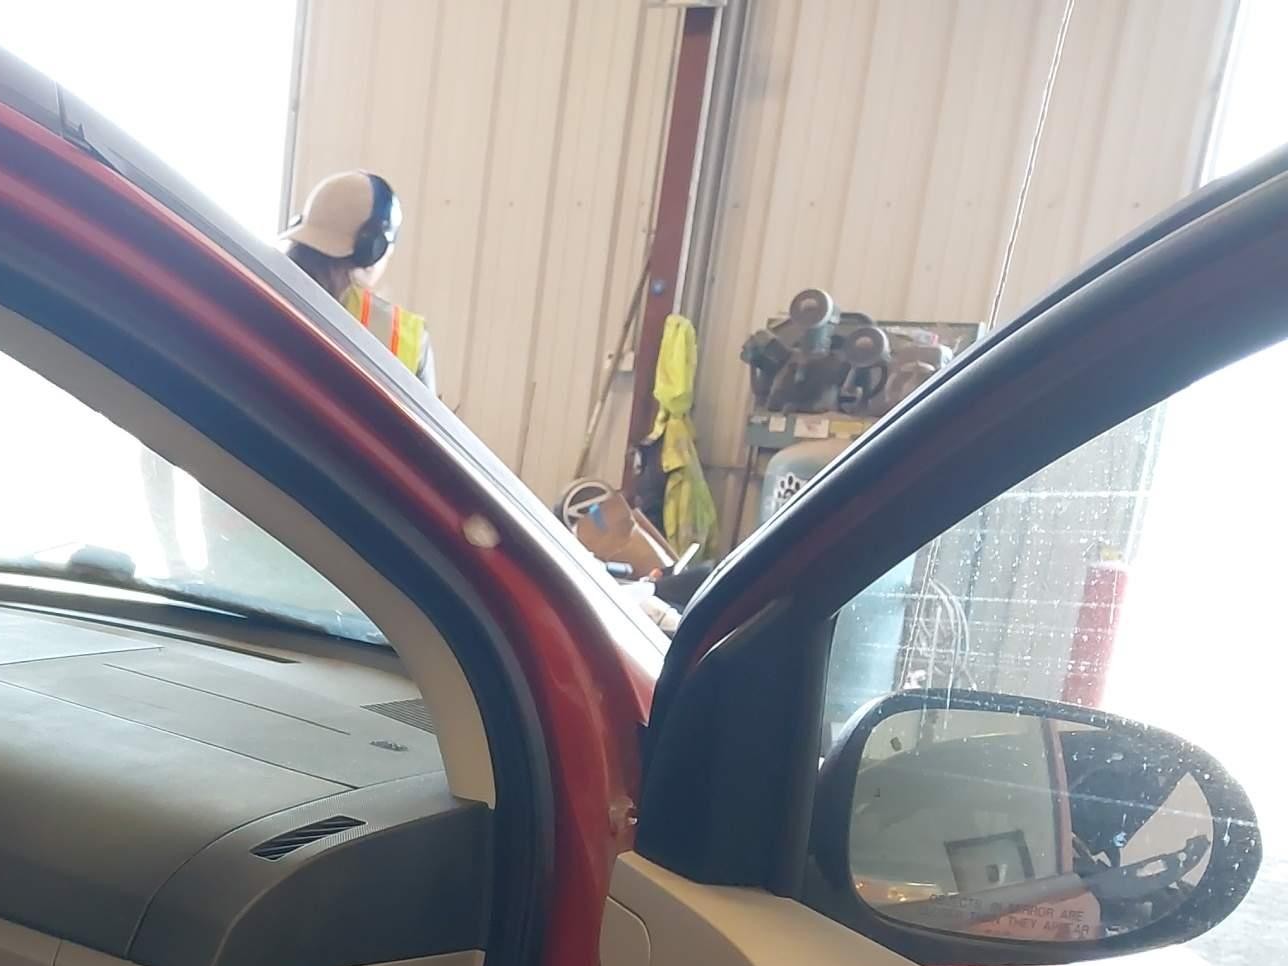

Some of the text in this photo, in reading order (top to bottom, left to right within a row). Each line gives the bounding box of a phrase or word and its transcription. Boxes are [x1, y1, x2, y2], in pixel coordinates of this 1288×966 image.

[929, 894, 980, 909] OBCTS
[1062, 910, 1085, 922] ARE
[1008, 917, 1035, 930] THEY
